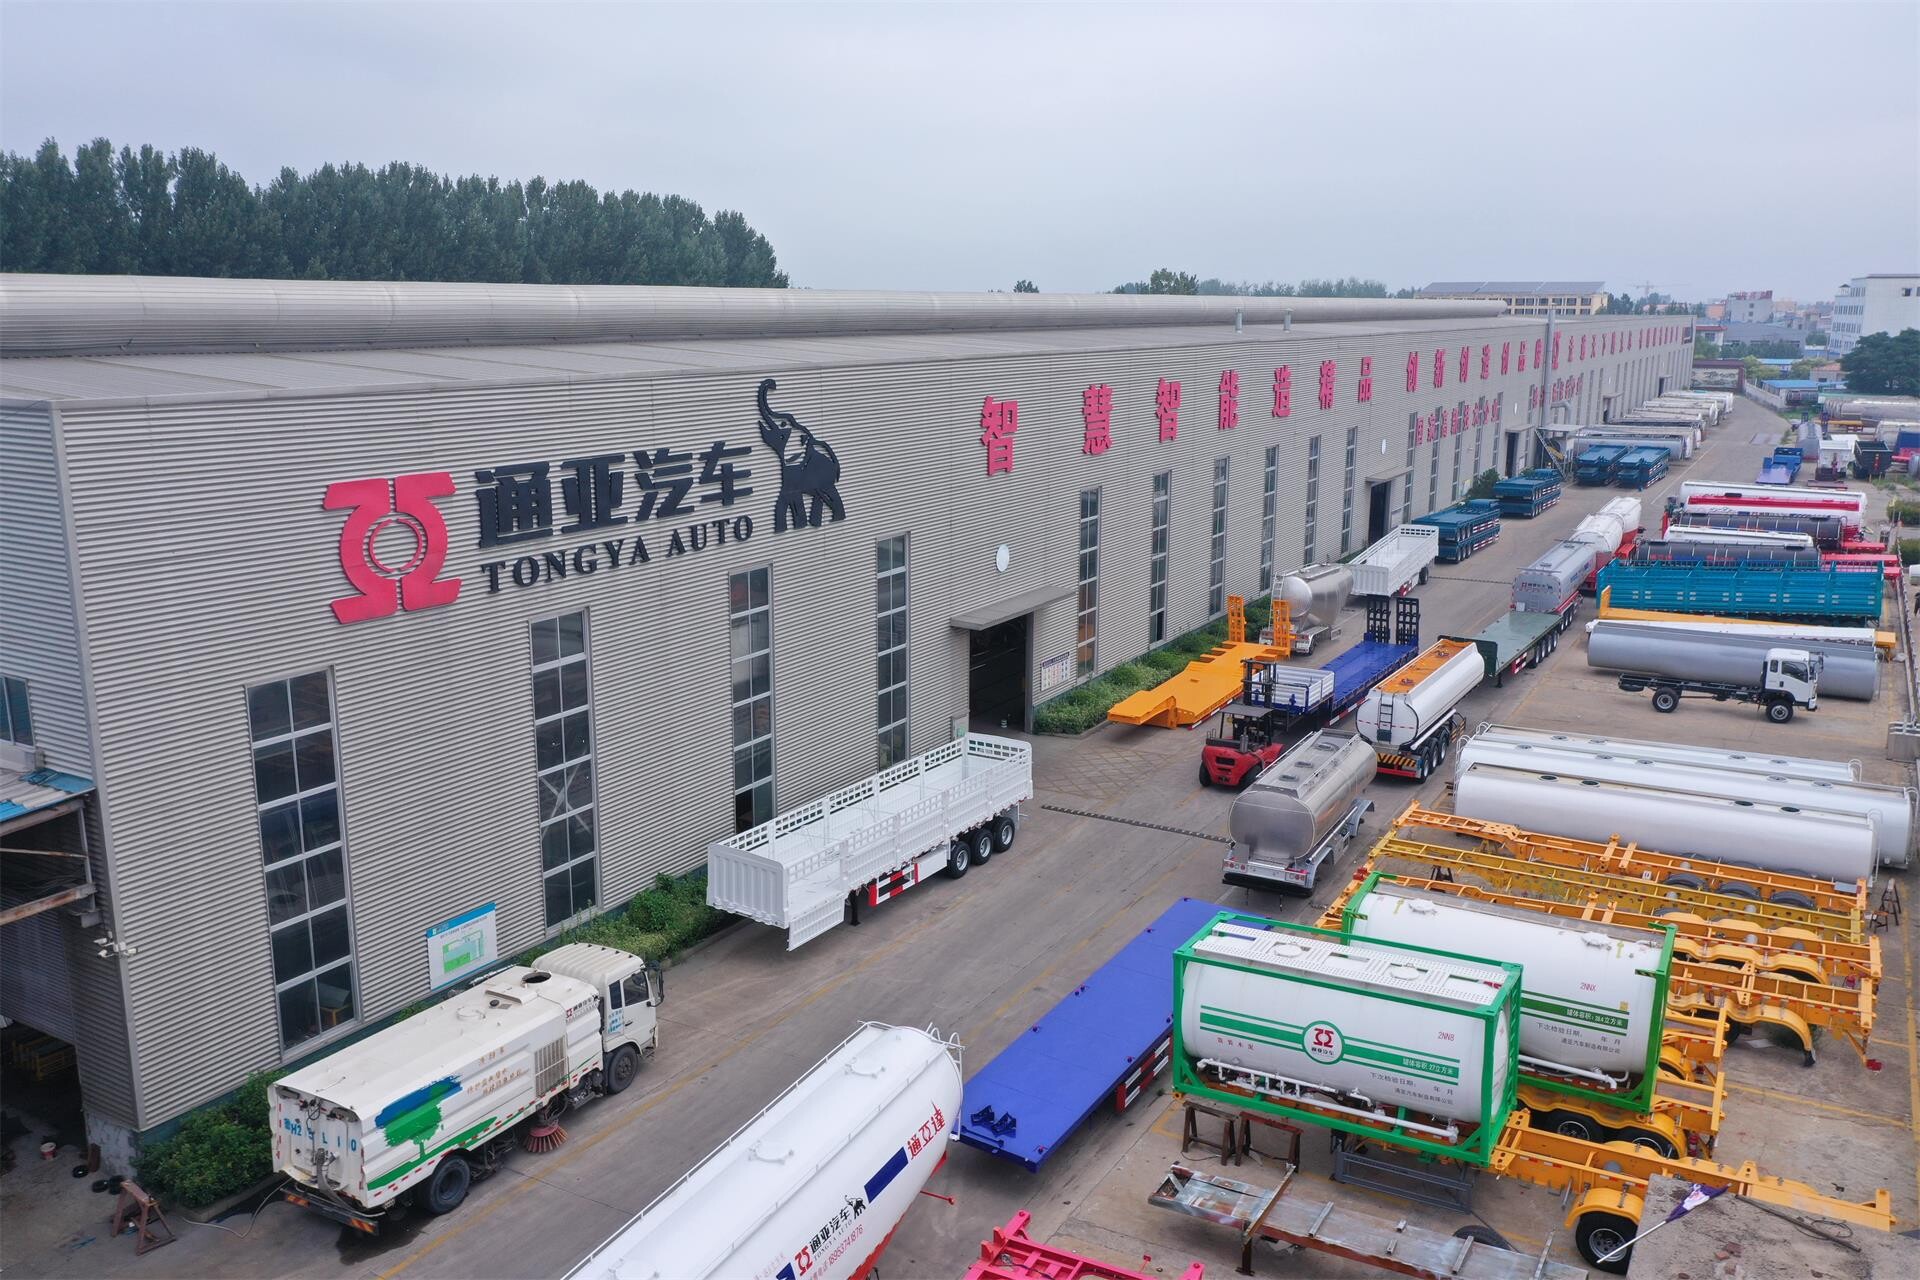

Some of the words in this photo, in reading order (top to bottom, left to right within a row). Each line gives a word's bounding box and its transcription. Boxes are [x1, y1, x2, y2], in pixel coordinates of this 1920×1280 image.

[979, 355, 1373, 476] 智慧智能造精品
[475, 441, 753, 549] 通亚汽车
[481, 536, 650, 594] TONGYA
[665, 515, 753, 557] AUTO
[809, 1206, 851, 1254] 通亚汽车
